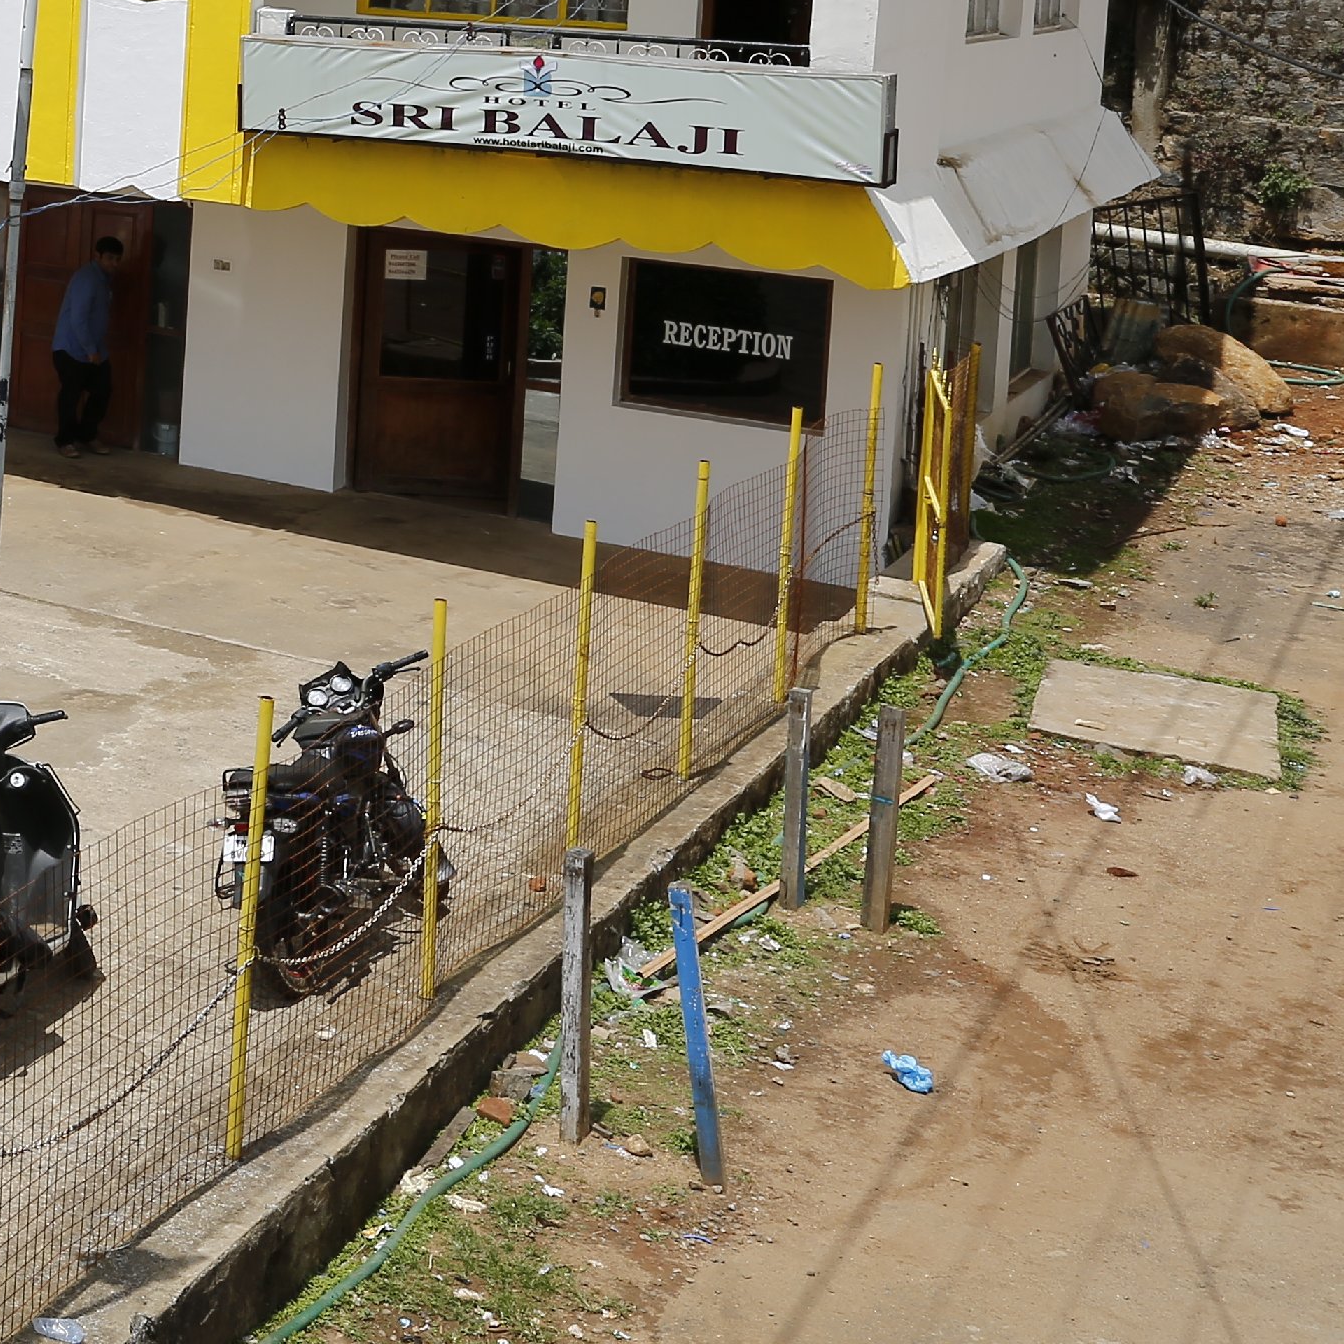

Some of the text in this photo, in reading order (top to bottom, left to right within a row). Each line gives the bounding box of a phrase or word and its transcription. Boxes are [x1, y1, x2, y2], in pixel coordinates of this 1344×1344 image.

[483, 95, 597, 111] HOTEL
[350, 101, 745, 156] SRI BALAJI
[473, 136, 604, 155] www.hotelsribalaji.com
[662, 320, 794, 360] RECEPTION
